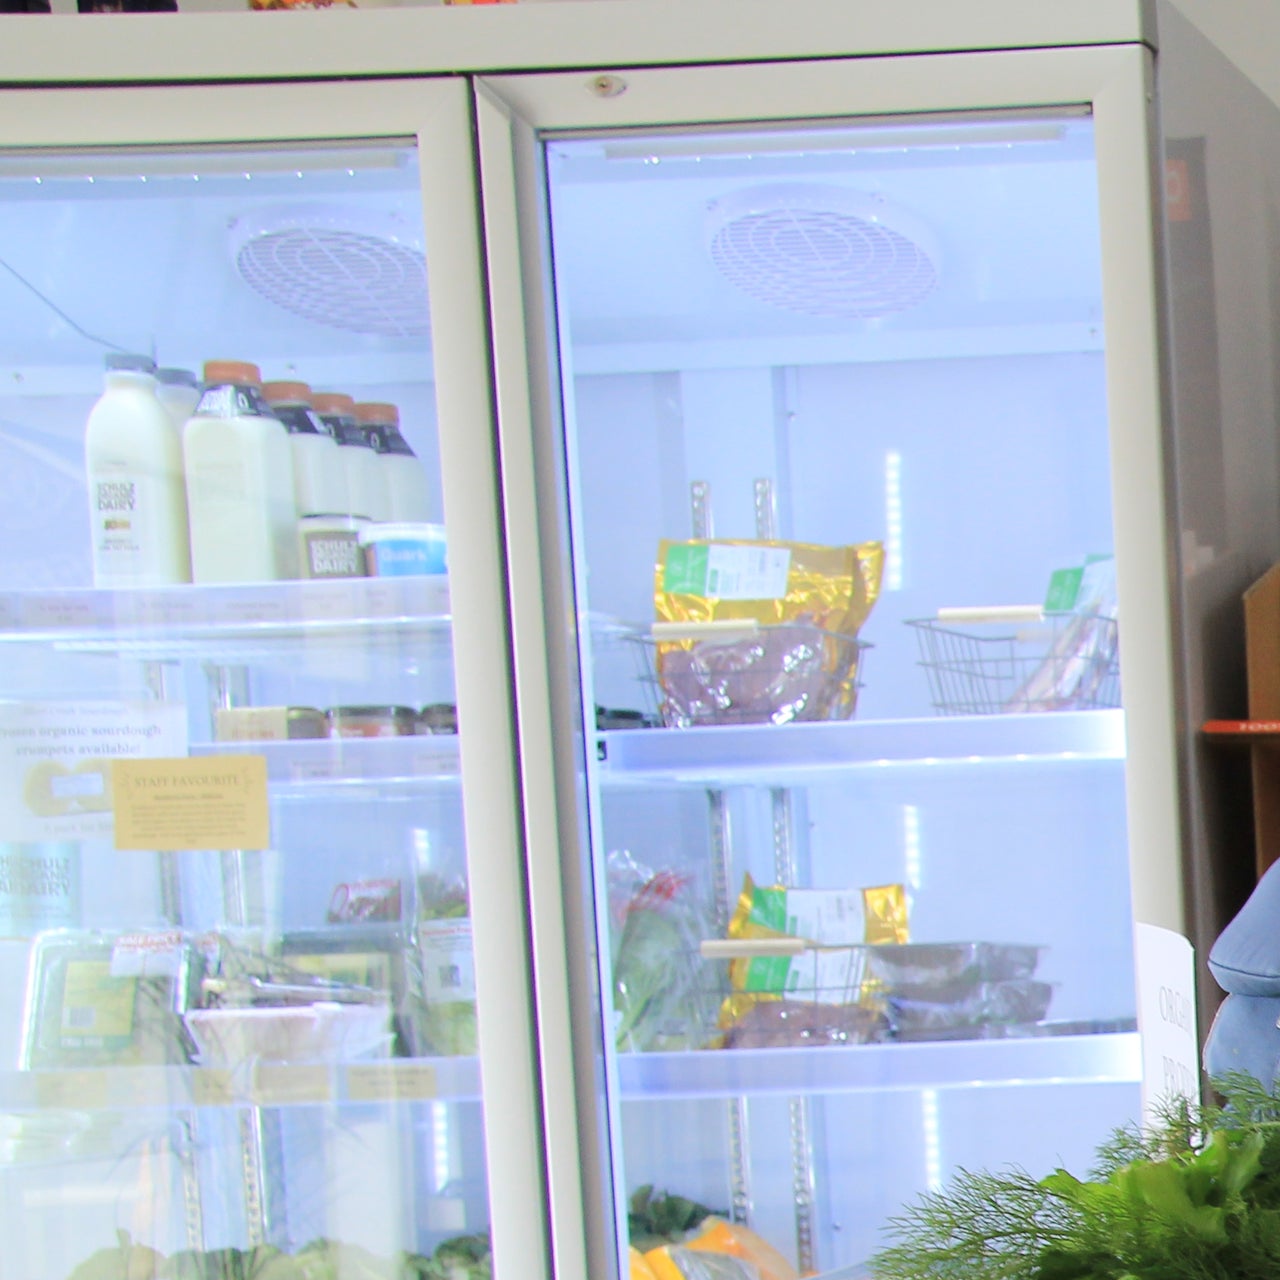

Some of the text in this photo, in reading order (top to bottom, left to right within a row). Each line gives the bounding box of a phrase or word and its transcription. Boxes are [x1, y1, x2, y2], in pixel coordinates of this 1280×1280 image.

[97, 499, 136, 512] DAIRY
[312, 559, 358, 574] DAIRY
[134, 774, 241, 788] STAFF FAVOURITE
